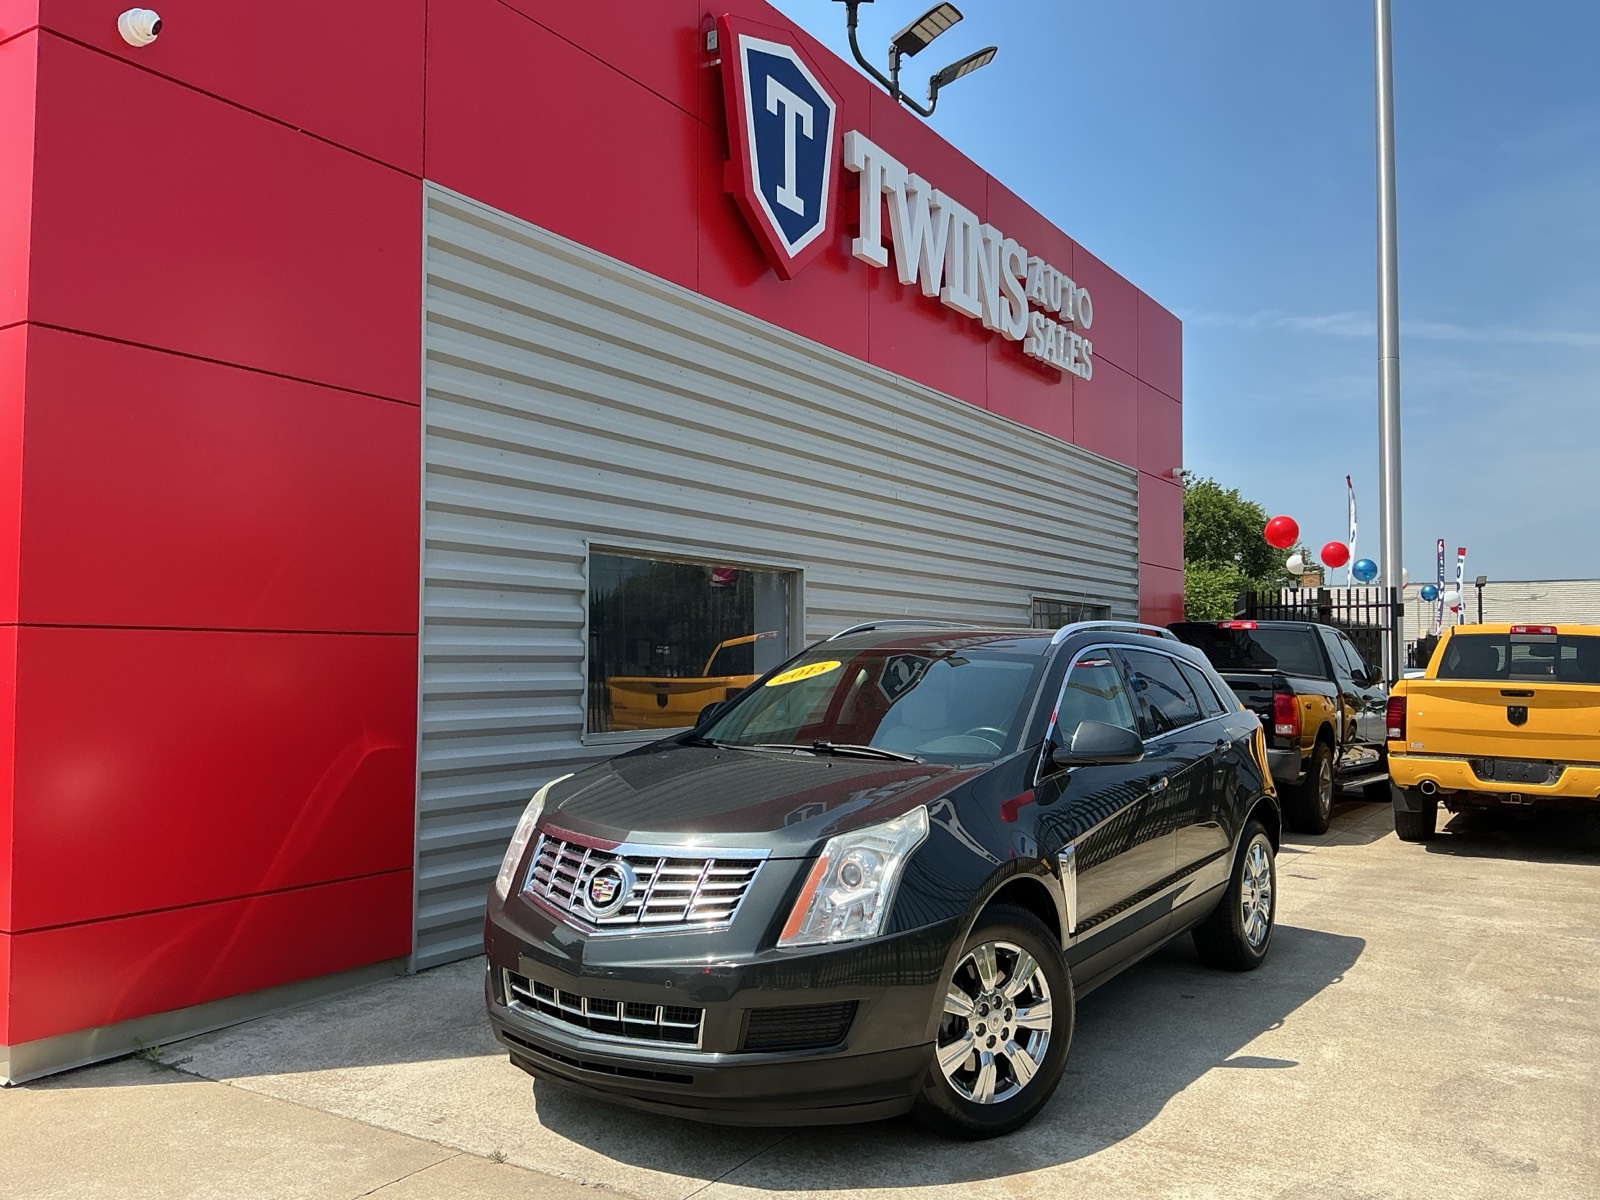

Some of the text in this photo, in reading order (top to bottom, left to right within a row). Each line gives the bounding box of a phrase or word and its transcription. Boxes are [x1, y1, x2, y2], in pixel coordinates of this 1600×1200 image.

[767, 74, 813, 217] T
[844, 130, 1028, 341] TWINS
[1023, 311, 1093, 381] SALES
[1026, 256, 1093, 330] AUTO
